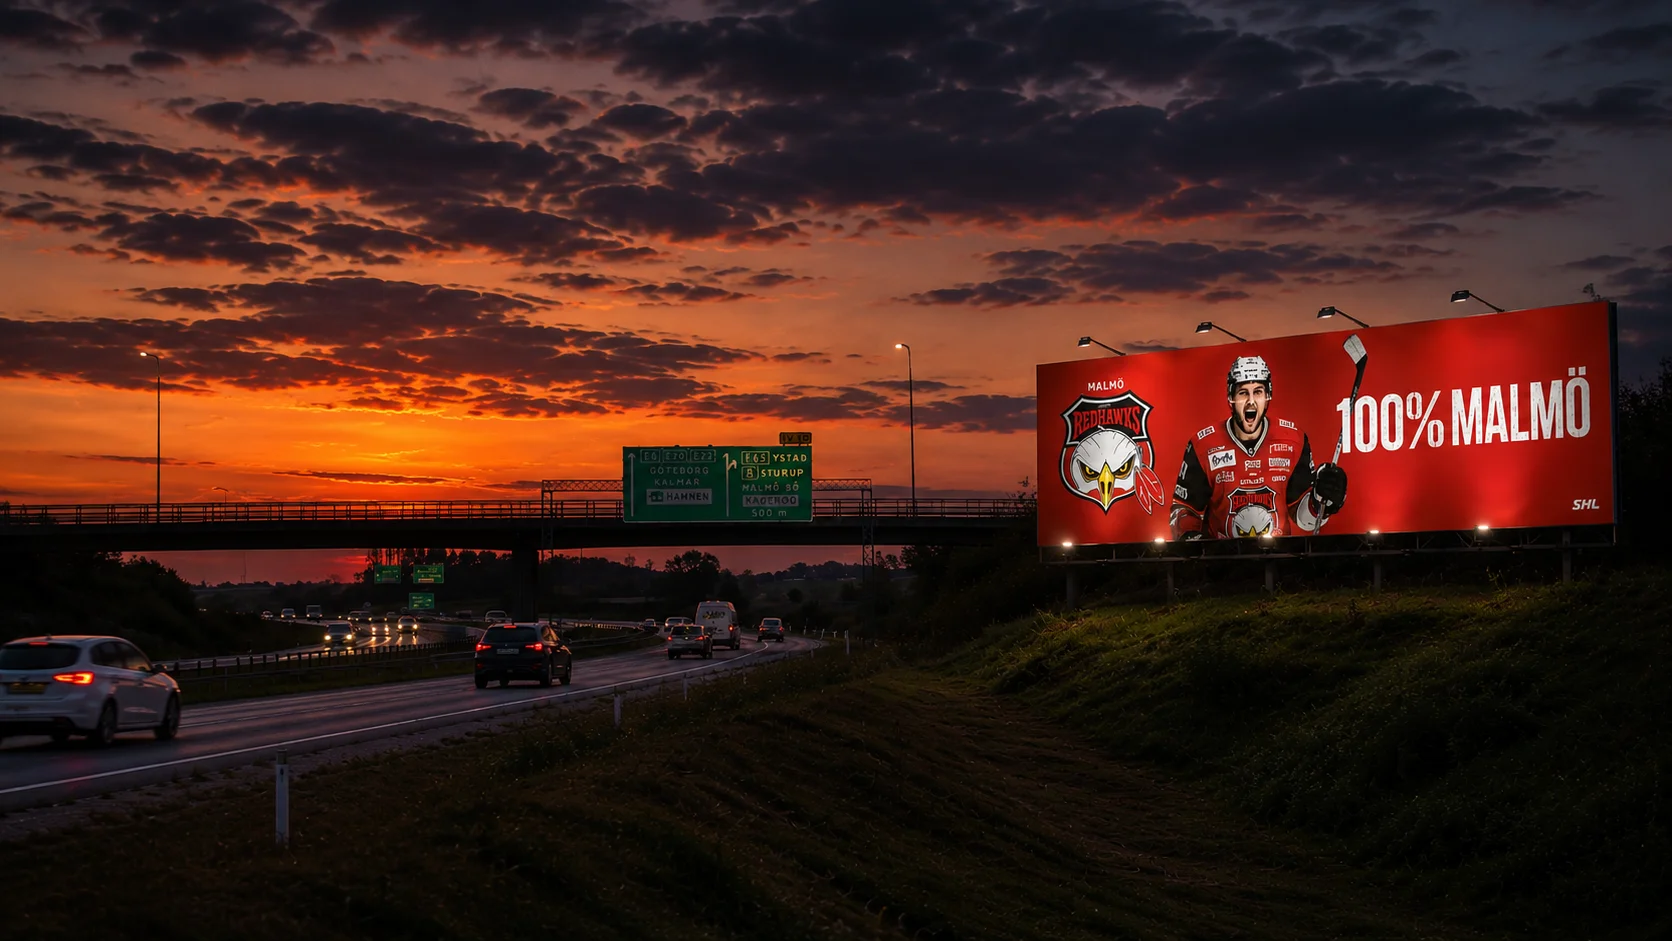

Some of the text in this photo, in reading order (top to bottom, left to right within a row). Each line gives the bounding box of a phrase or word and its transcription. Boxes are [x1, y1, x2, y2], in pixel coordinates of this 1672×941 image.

[1087, 377, 1125, 391] MALMÖ
[1336, 366, 1591, 454] 100% MALMÖ
[1073, 405, 1141, 440] REDHAWKS
[745, 453, 807, 463] E65 YSTAD
[649, 464, 709, 475] GÖTEBORG
[760, 468, 804, 478] STURUP
[654, 478, 700, 486] KALMAR
[1572, 498, 1600, 511] SHL
[752, 508, 773, 517] 500
